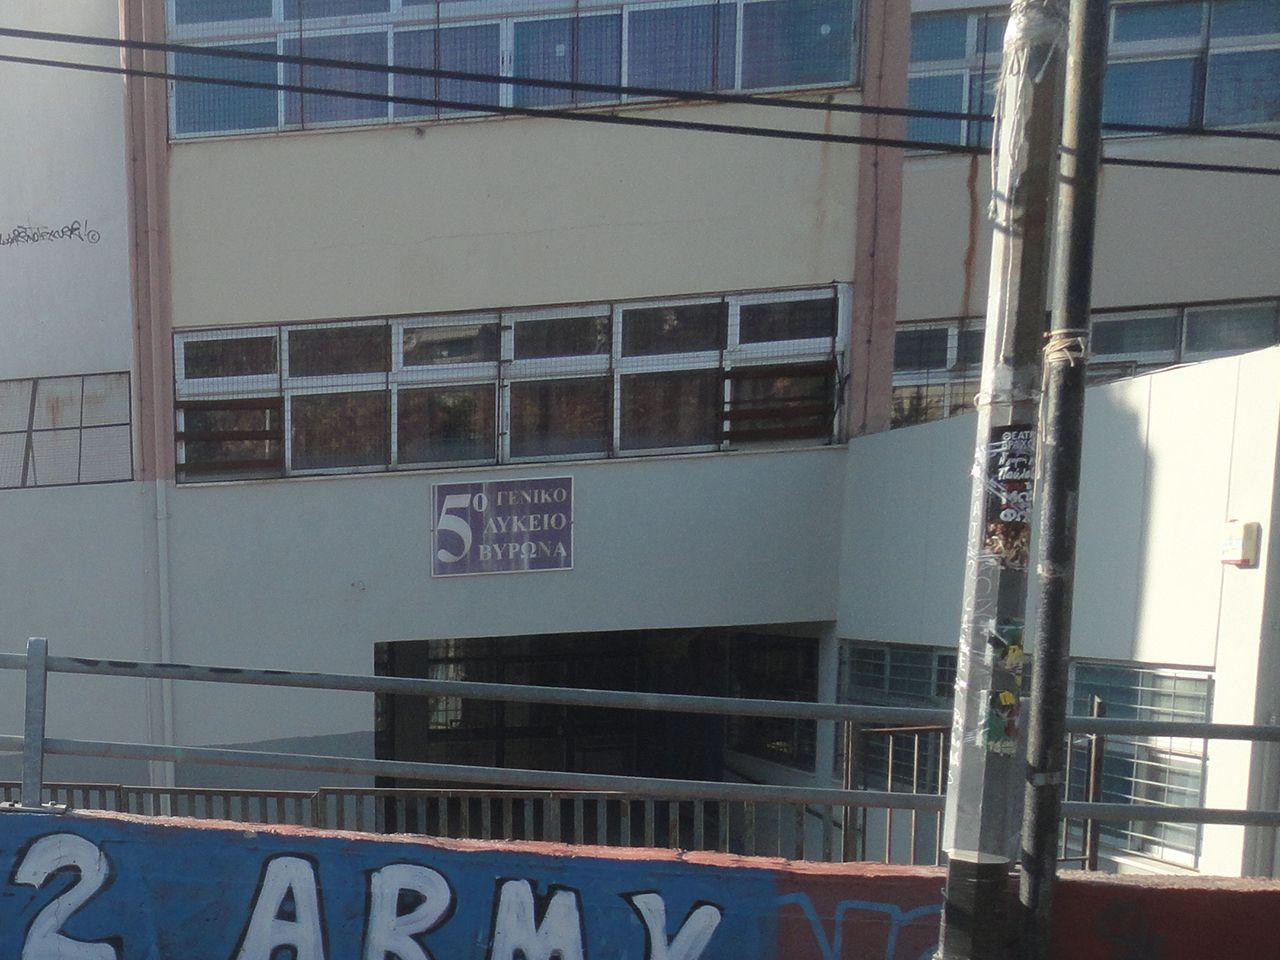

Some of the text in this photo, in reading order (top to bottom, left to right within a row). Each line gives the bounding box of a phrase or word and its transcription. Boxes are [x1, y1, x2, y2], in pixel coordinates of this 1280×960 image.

[495, 487, 567, 507] ΓΕΝΙΚΟ
[483, 512, 567, 534] ΛΥΚΕΙΟ
[478, 541, 568, 561] ΒΥΡΩΝΑ
